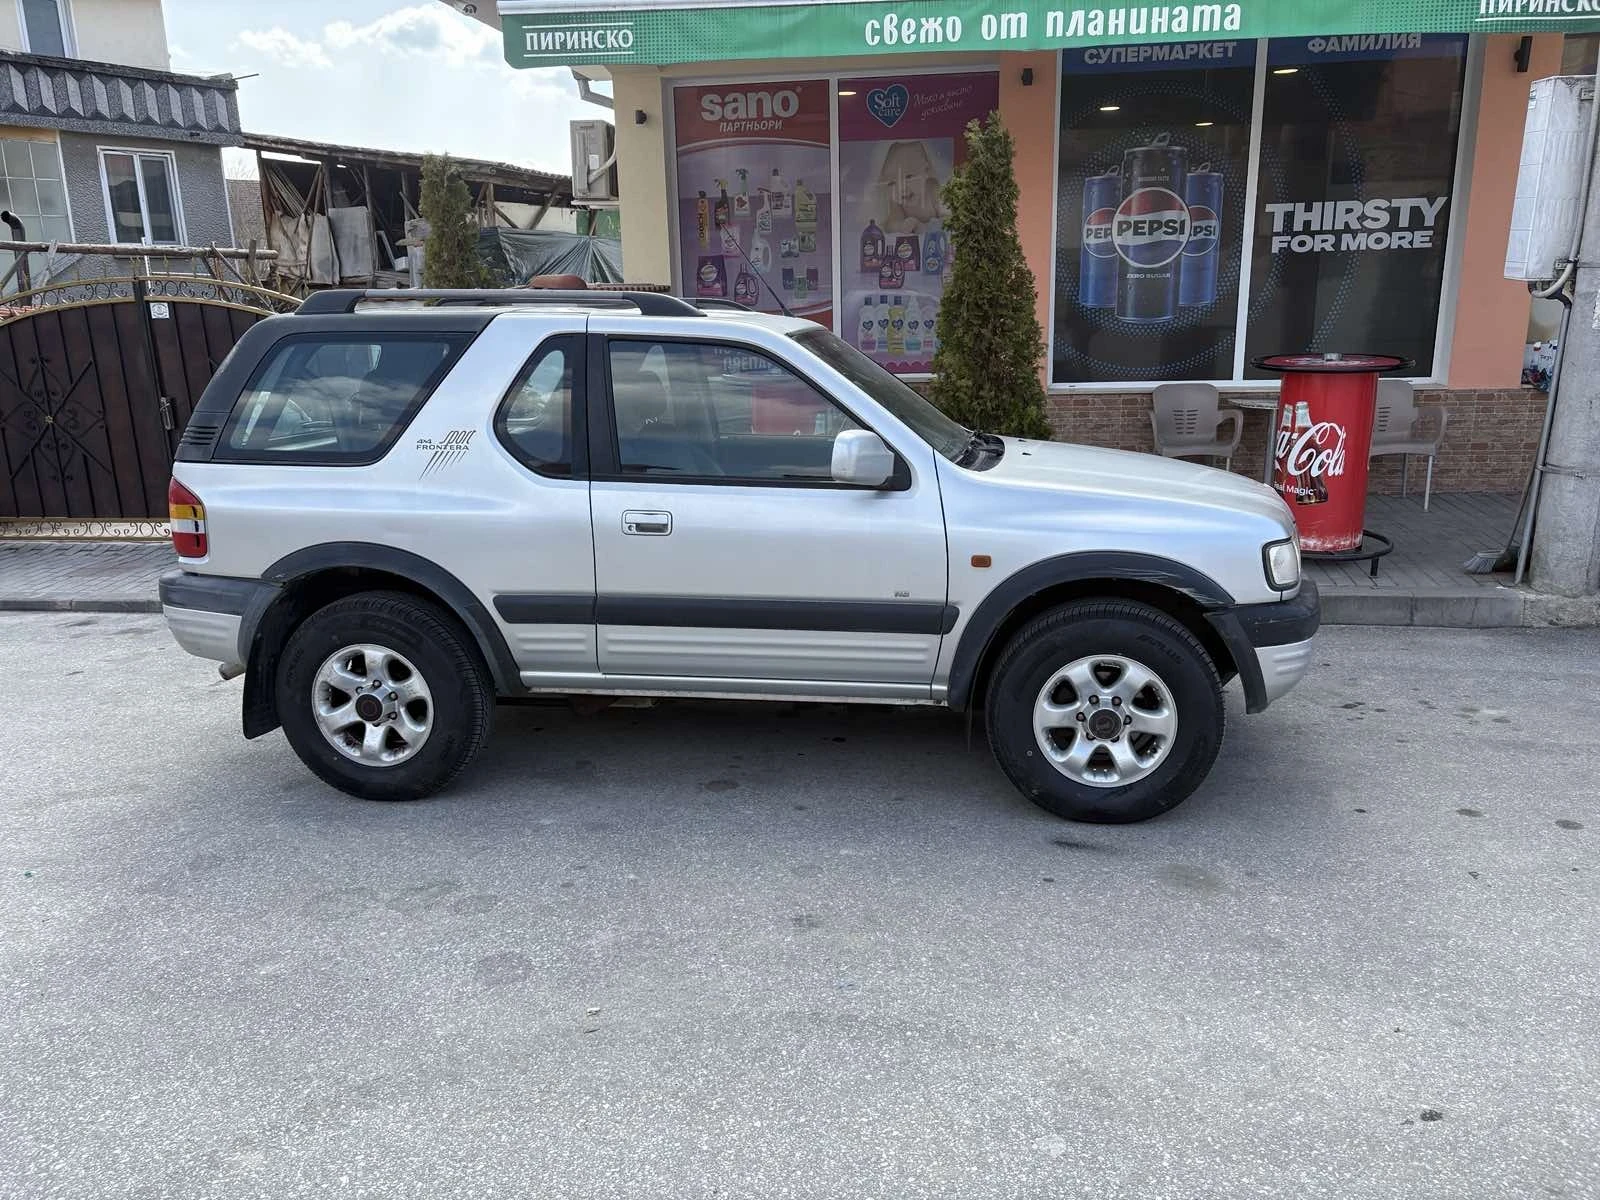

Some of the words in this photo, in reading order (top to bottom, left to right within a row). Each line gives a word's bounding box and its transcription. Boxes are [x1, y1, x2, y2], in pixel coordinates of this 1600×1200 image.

[865, 13, 962, 46] свежо
[981, 11, 1028, 41] от
[1046, 3, 1241, 38] планината
[526, 29, 634, 50] ПИРИНСКО
[1307, 33, 1422, 53] ФАМИЛИЯ
[1084, 42, 1237, 65] СУПЕРМАРКЕТ
[701, 89, 800, 121] sano
[874, 92, 901, 109] Soft
[878, 106, 901, 117] care
[719, 120, 784, 133] ПАРТНЬОРИ
[1265, 196, 1448, 233] THIRSTY
[1086, 227, 1113, 240] PEP
[1117, 218, 1186, 237] PEPSI
[1189, 224, 1217, 238] PSI
[1271, 234, 1336, 254] FOR
[1340, 230, 1434, 251] MORE
[1286, 484, 1314, 496] Magic
